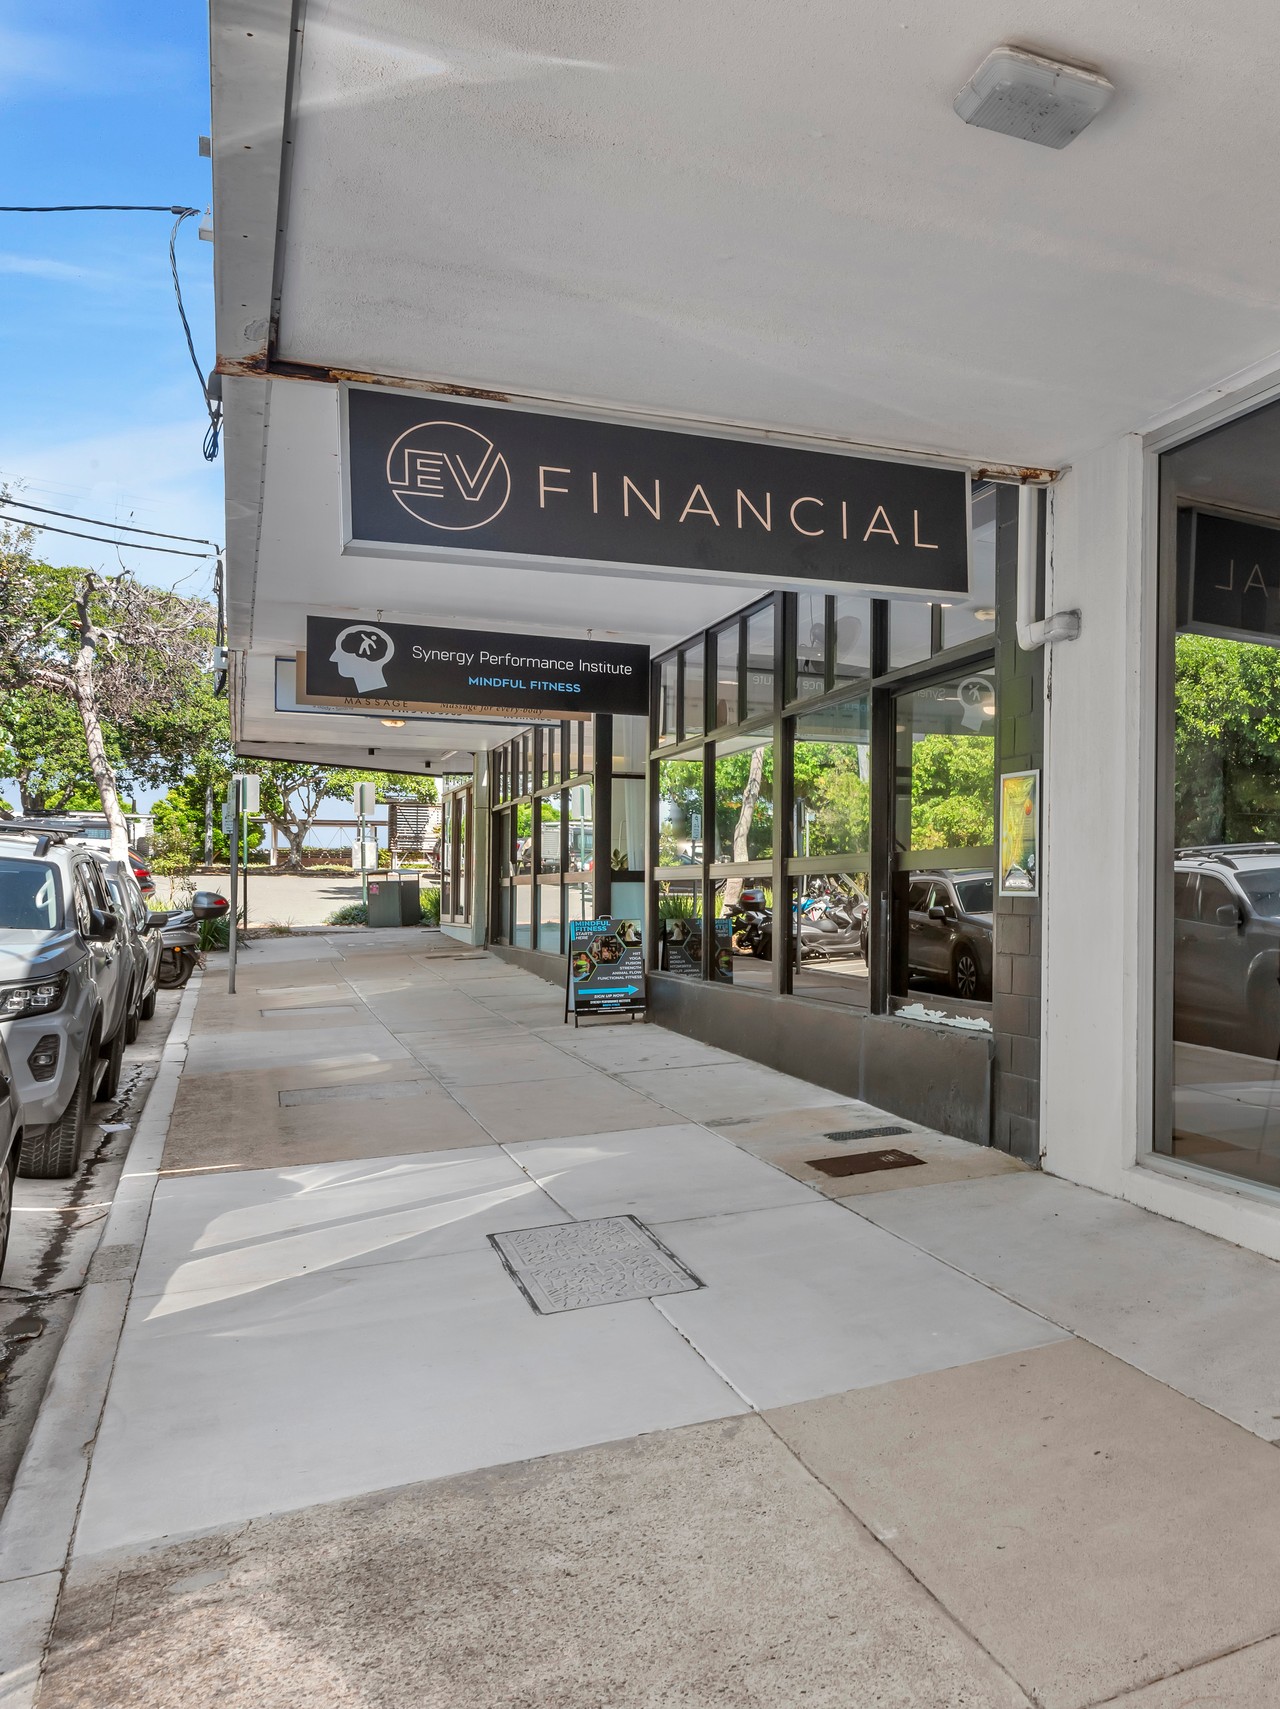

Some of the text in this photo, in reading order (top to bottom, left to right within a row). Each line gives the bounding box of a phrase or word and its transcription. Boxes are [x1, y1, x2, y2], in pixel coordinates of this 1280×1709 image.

[538, 465, 939, 550] FINANCIAL
[412, 645, 633, 676] Synergy Performance Institute
[468, 676, 582, 693] MINDFUL FITNESS
[344, 697, 409, 708] MASSAGE
